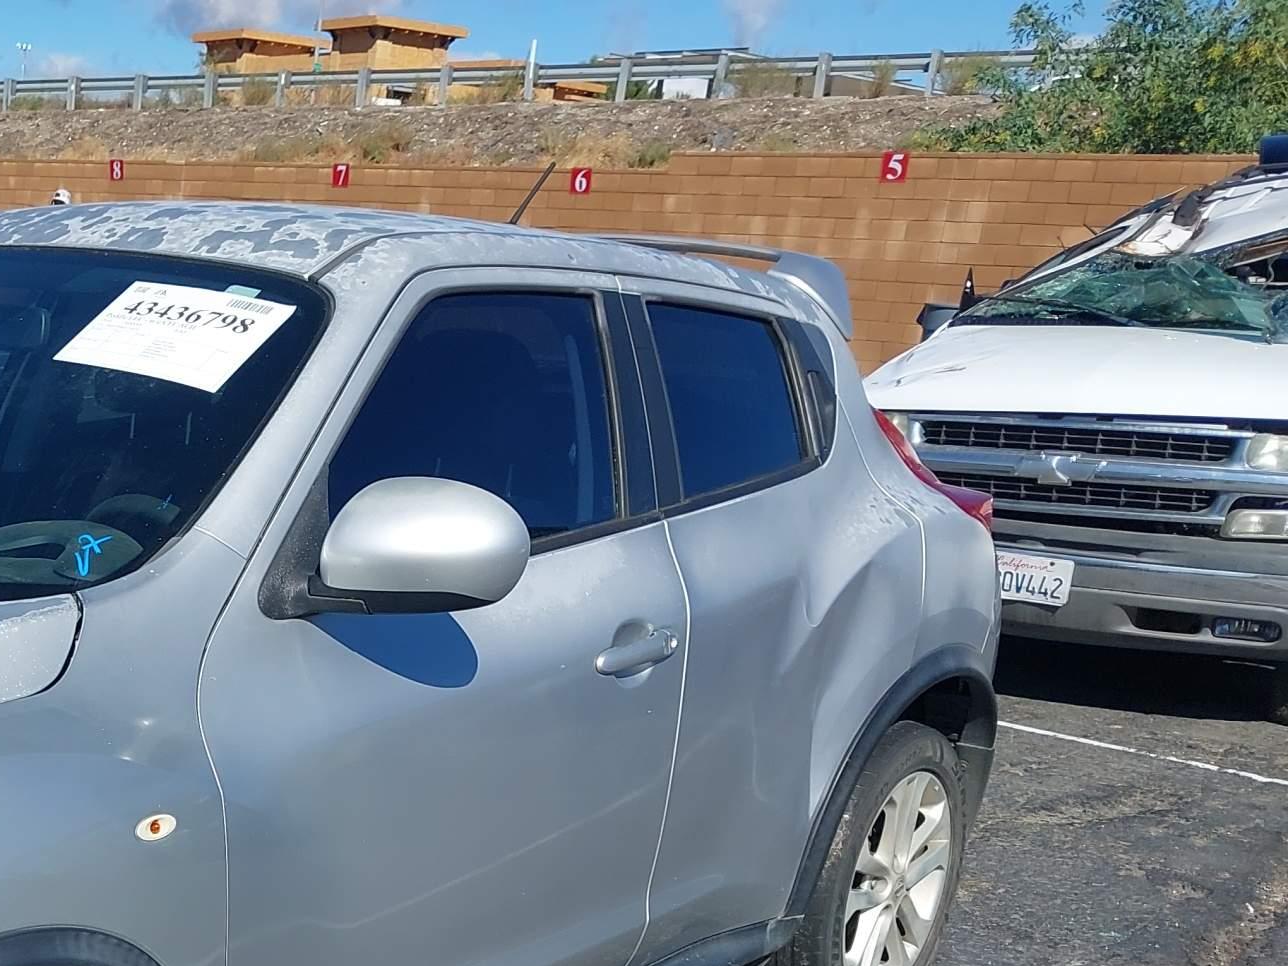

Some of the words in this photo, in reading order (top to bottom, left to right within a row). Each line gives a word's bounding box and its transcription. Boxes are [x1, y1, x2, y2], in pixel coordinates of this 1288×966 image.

[112, 161, 121, 179] 8
[336, 164, 347, 186] 7
[887, 153, 905, 181] 5
[574, 169, 588, 192] 6
[123, 300, 257, 335] 43436798
[999, 570, 1064, 599] OV442
